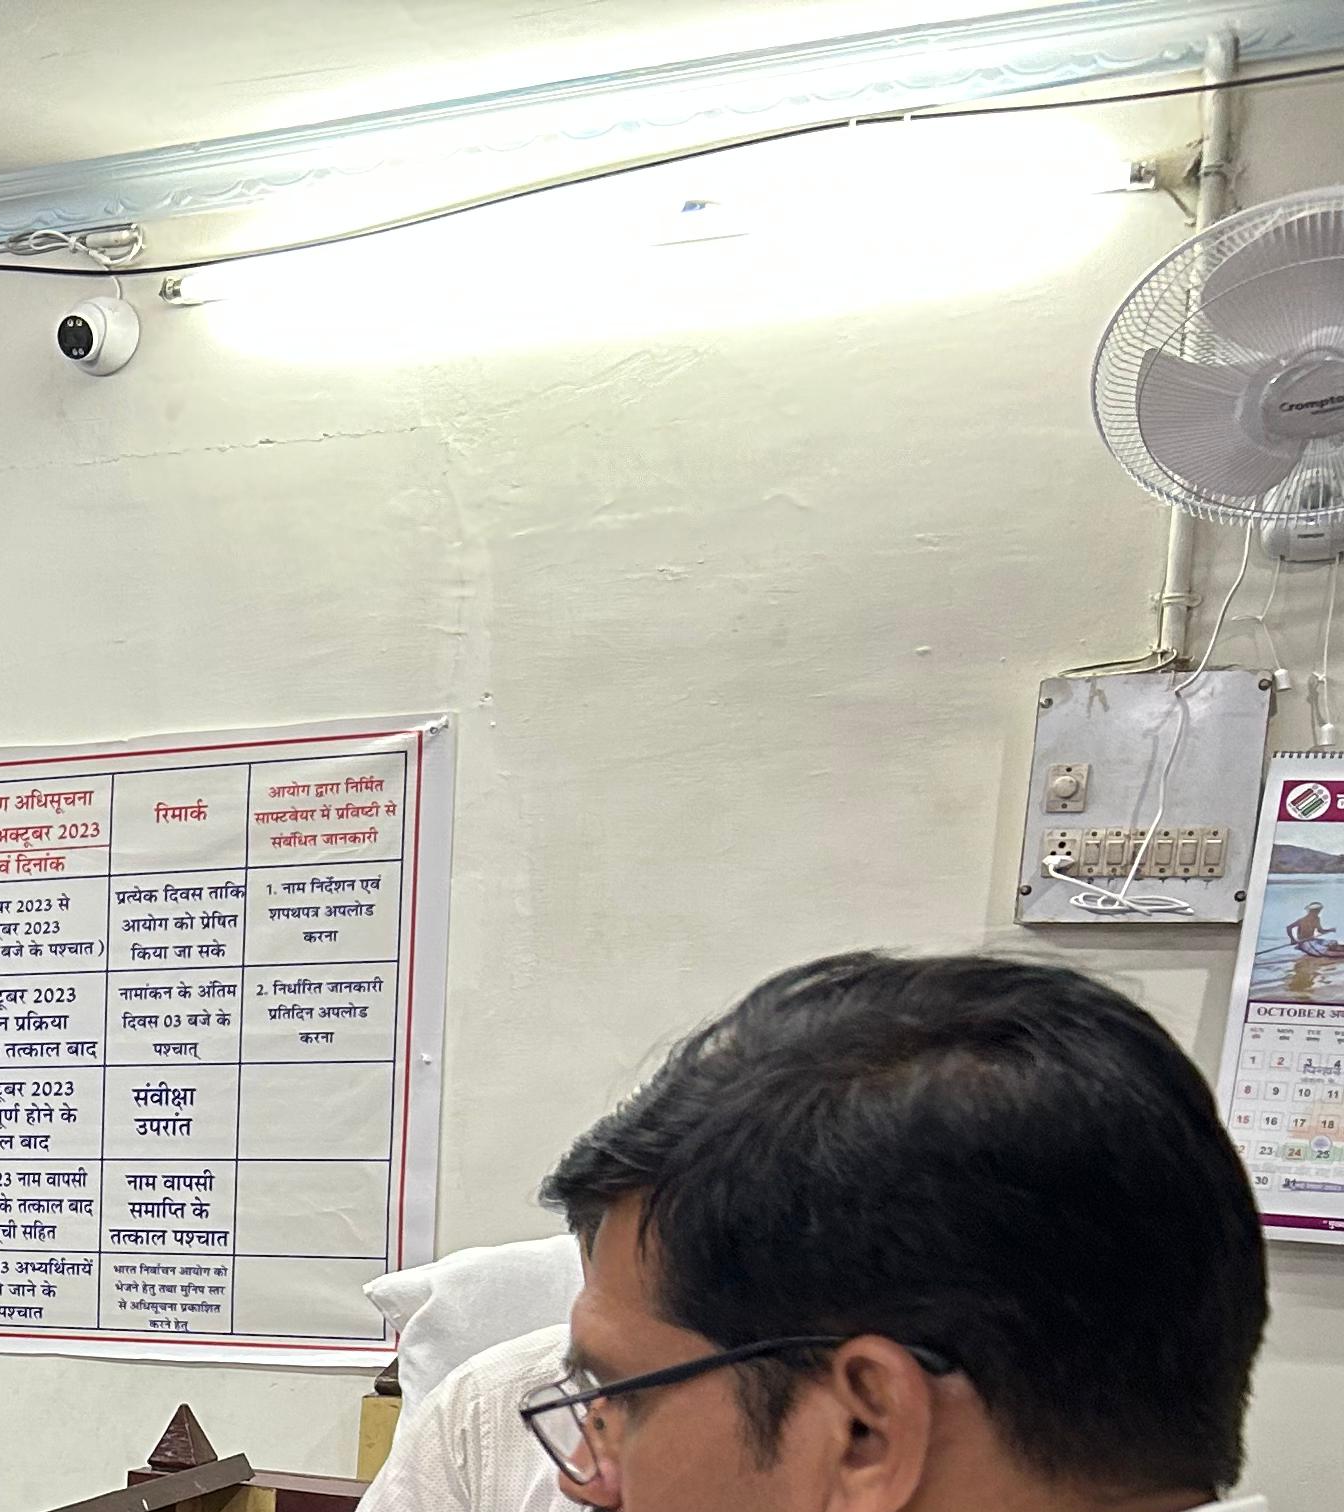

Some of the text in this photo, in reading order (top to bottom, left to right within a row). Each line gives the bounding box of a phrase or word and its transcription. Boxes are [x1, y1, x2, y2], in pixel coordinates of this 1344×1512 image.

[154, 799, 208, 823] रिमार्क
[58, 822, 100, 840] 2023
[15, 853, 66, 875] दिनांक
[116, 885, 157, 904] प्रत्येक
[165, 884, 202, 903] दिवस
[266, 884, 276, 895] 1.
[281, 882, 306, 894] नाम
[359, 874, 381, 894] एवं
[16, 898, 53, 913] 2023
[56, 892, 70, 911] से
[24, 920, 60, 935] 2023
[122, 914, 169, 932] आयोग
[173, 912, 196, 930] को
[302, 930, 339, 943] करना
[130, 939, 226, 960] किया जा सके
[33, 987, 76, 1004] 2023
[118, 980, 237, 1000] नामांकन के अंतिम
[14, 1010, 69, 1031] प्रक्रिया
[122, 1009, 231, 1030] दिवस 03 बजे के
[1257, 1006, 1325, 1019] OCTOBER
[4, 1042, 61, 1057] तत्काल
[66, 1042, 98, 1058] बाद
[31, 1081, 74, 1096] 2023
[1298, 1088, 1311, 1098] 10
[1328, 1090, 1340, 1099] 11
[24, 1103, 54, 1126] होने
[59, 1102, 78, 1123] के
[134, 1112, 193, 1136] उपरांत
[1265, 1117, 1335, 1129] 16 17 18
[19, 1135, 50, 1152] बाद
[16, 1173, 41, 1187] नाम
[45, 1167, 88, 1188] वापसी
[125, 1169, 216, 1192] नाम वापसी
[17, 1199, 64, 1214] तत्काल
[67, 1199, 94, 1216] बाद
[128, 1196, 210, 1219] समाप्ति के
[21, 1220, 57, 1242] सहित
[109, 1229, 230, 1248] तत्काल पश्चात
[8, 1280, 36, 1297] जाने
[40, 1280, 57, 1297] के
